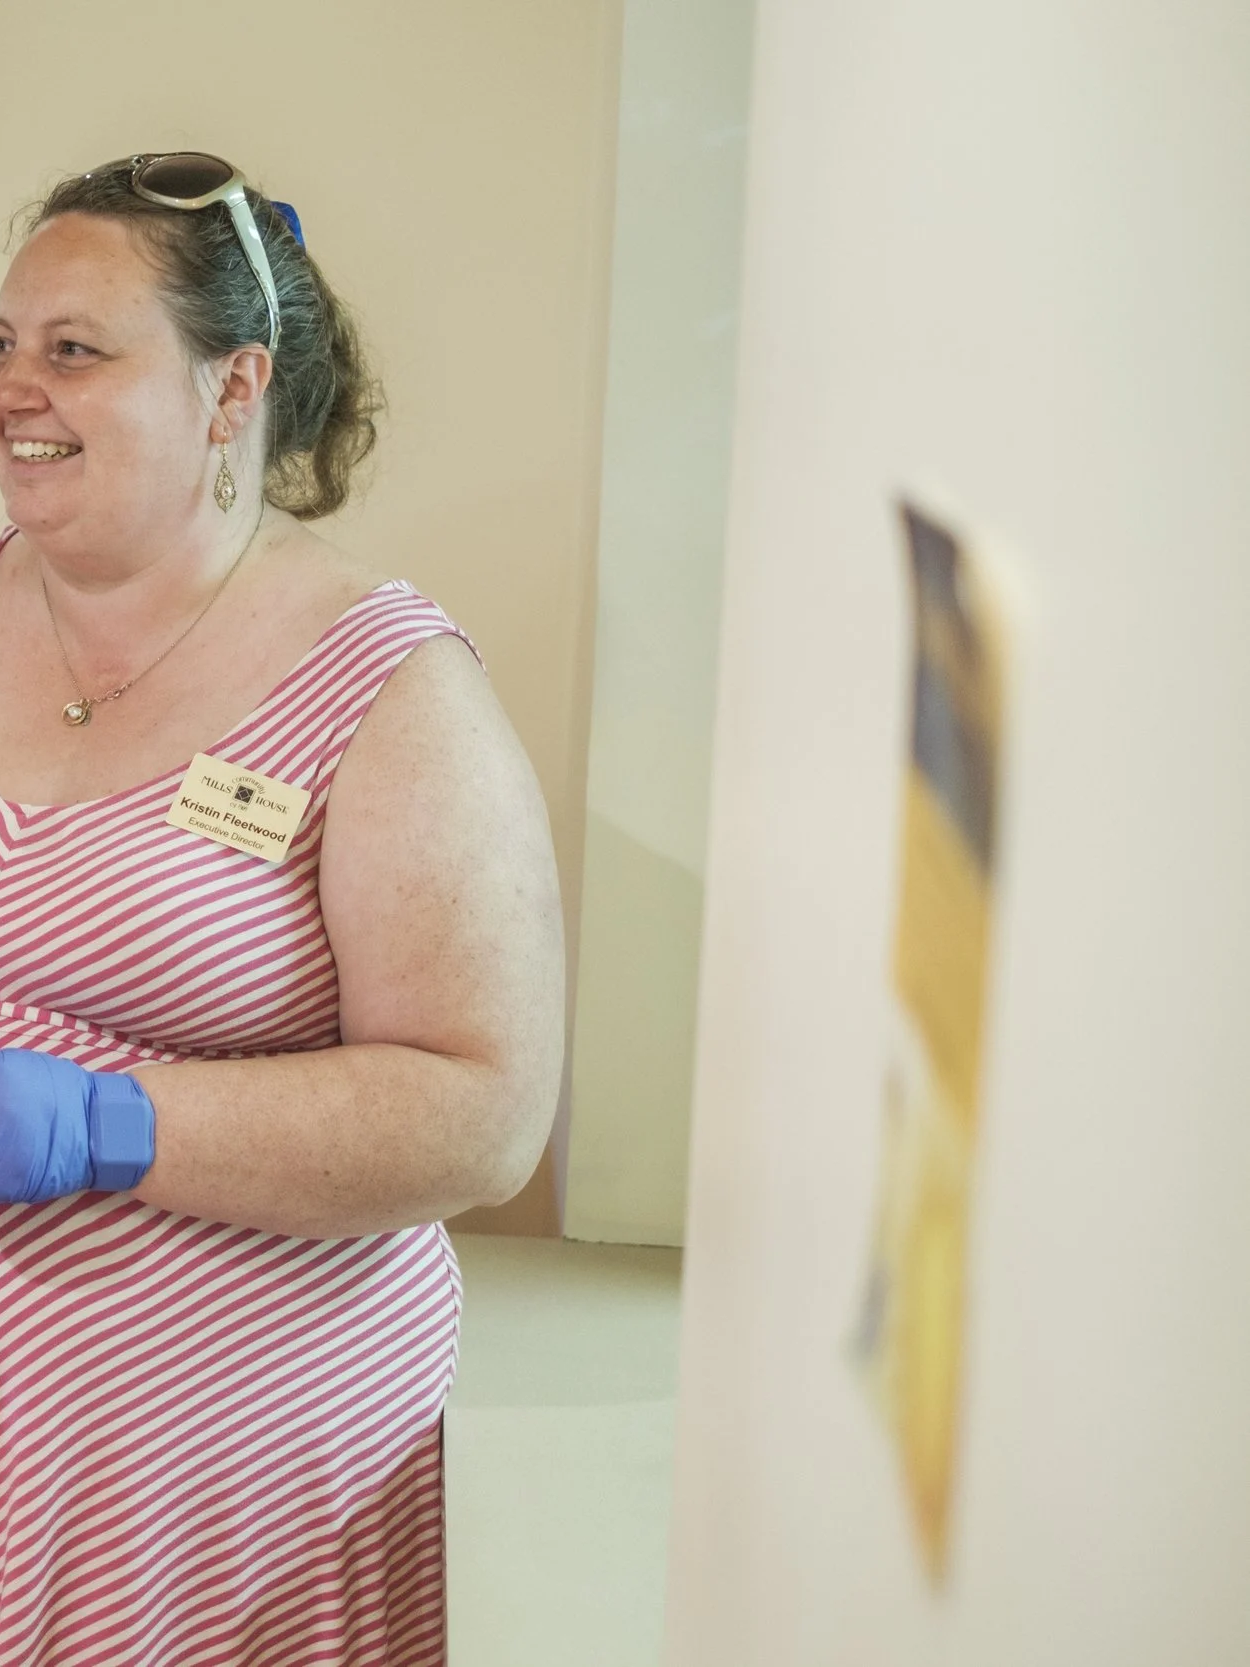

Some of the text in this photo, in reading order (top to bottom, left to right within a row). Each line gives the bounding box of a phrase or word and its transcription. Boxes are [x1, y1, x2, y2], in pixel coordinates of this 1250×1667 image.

[200, 775, 234, 794] MILLS
[255, 796, 289, 814] HOUSE
[180, 796, 287, 843] Kristin Fleetwood
[188, 816, 265, 850] Executive Director
